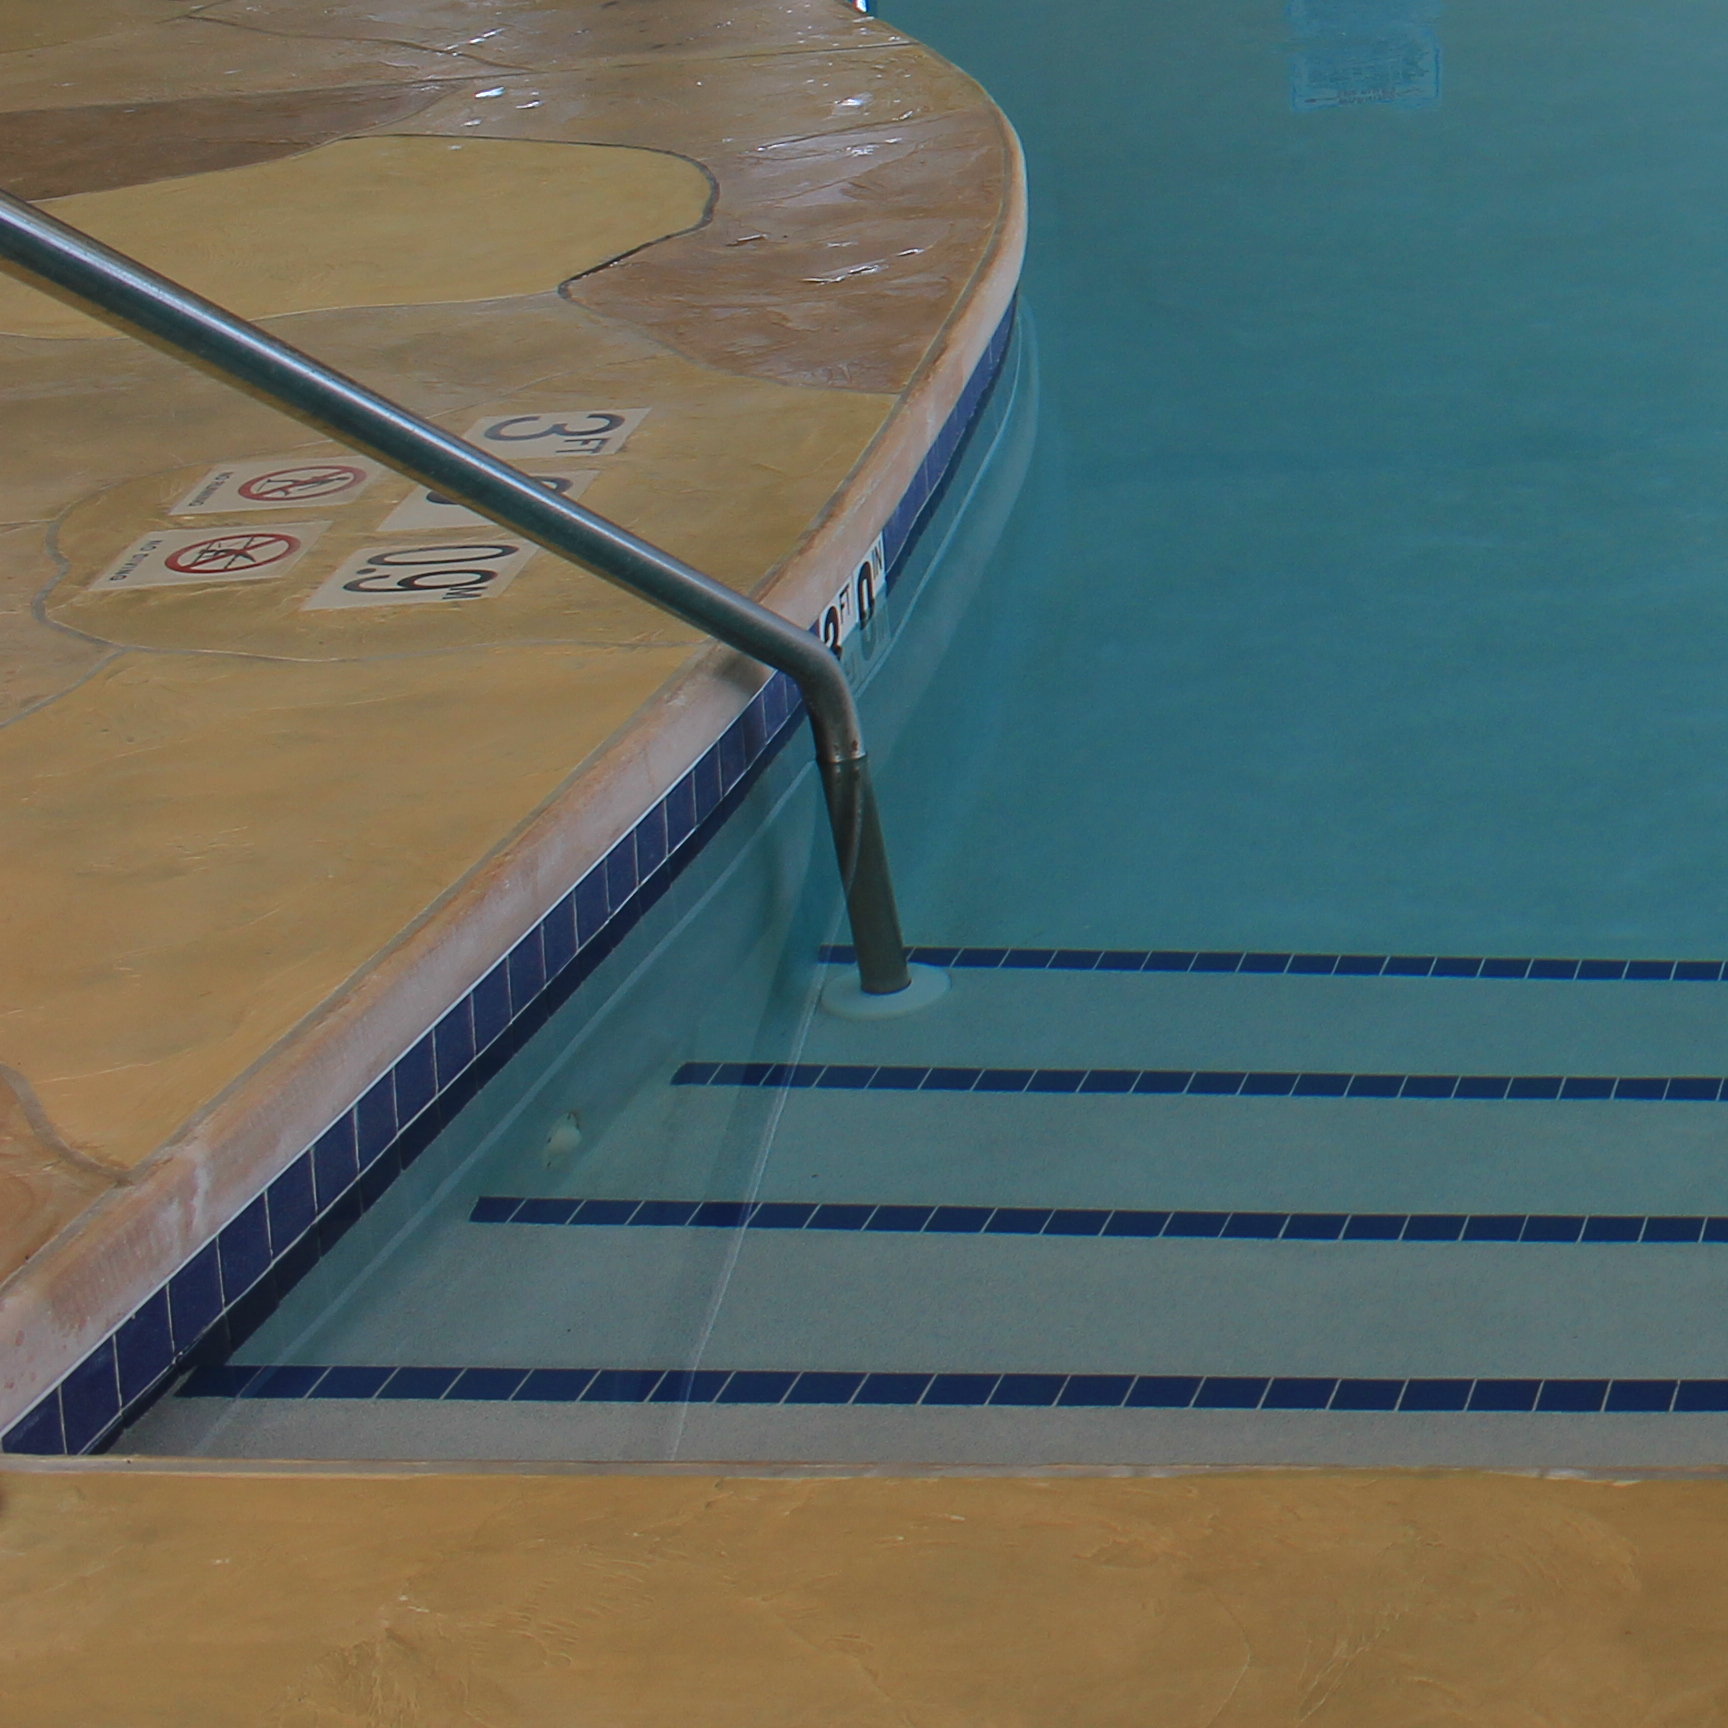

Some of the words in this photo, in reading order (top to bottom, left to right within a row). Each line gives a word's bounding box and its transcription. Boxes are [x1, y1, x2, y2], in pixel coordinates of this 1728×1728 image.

[483, 413, 626, 442] 3
[555, 437, 612, 455] FT
[342, 544, 520, 592] 0.9
[442, 586, 489, 600] M
[839, 582, 850, 625] FT
[857, 560, 875, 630] 0
